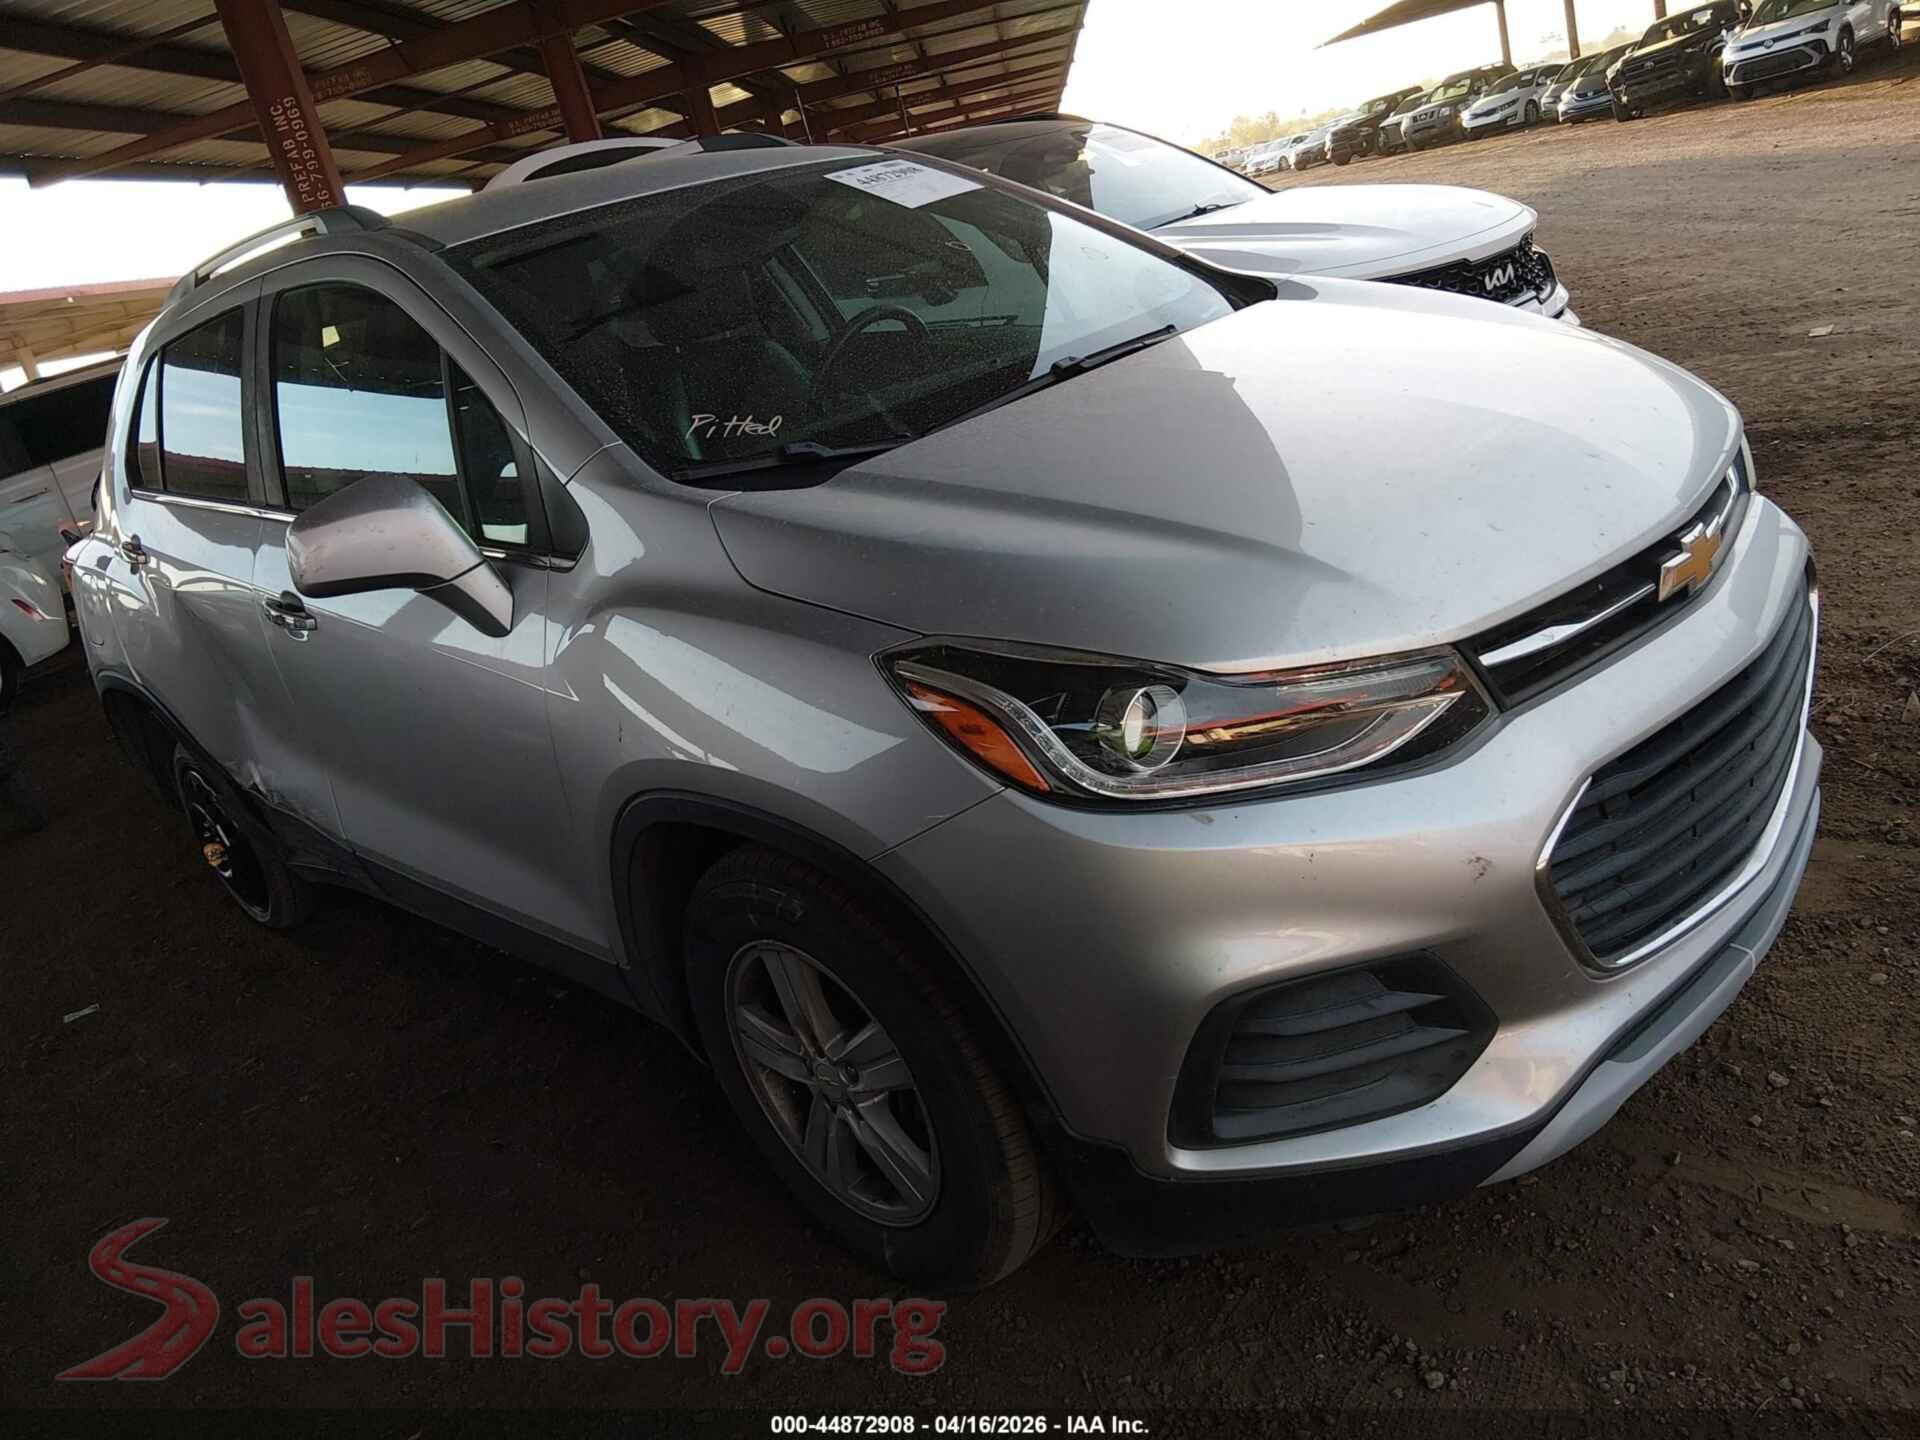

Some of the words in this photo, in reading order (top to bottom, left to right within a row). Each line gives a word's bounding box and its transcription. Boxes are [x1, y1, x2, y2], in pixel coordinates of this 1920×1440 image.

[269, 98, 290, 132] INC.
[282, 139, 315, 203] PREFAB
[685, 413, 783, 439] Pitted
